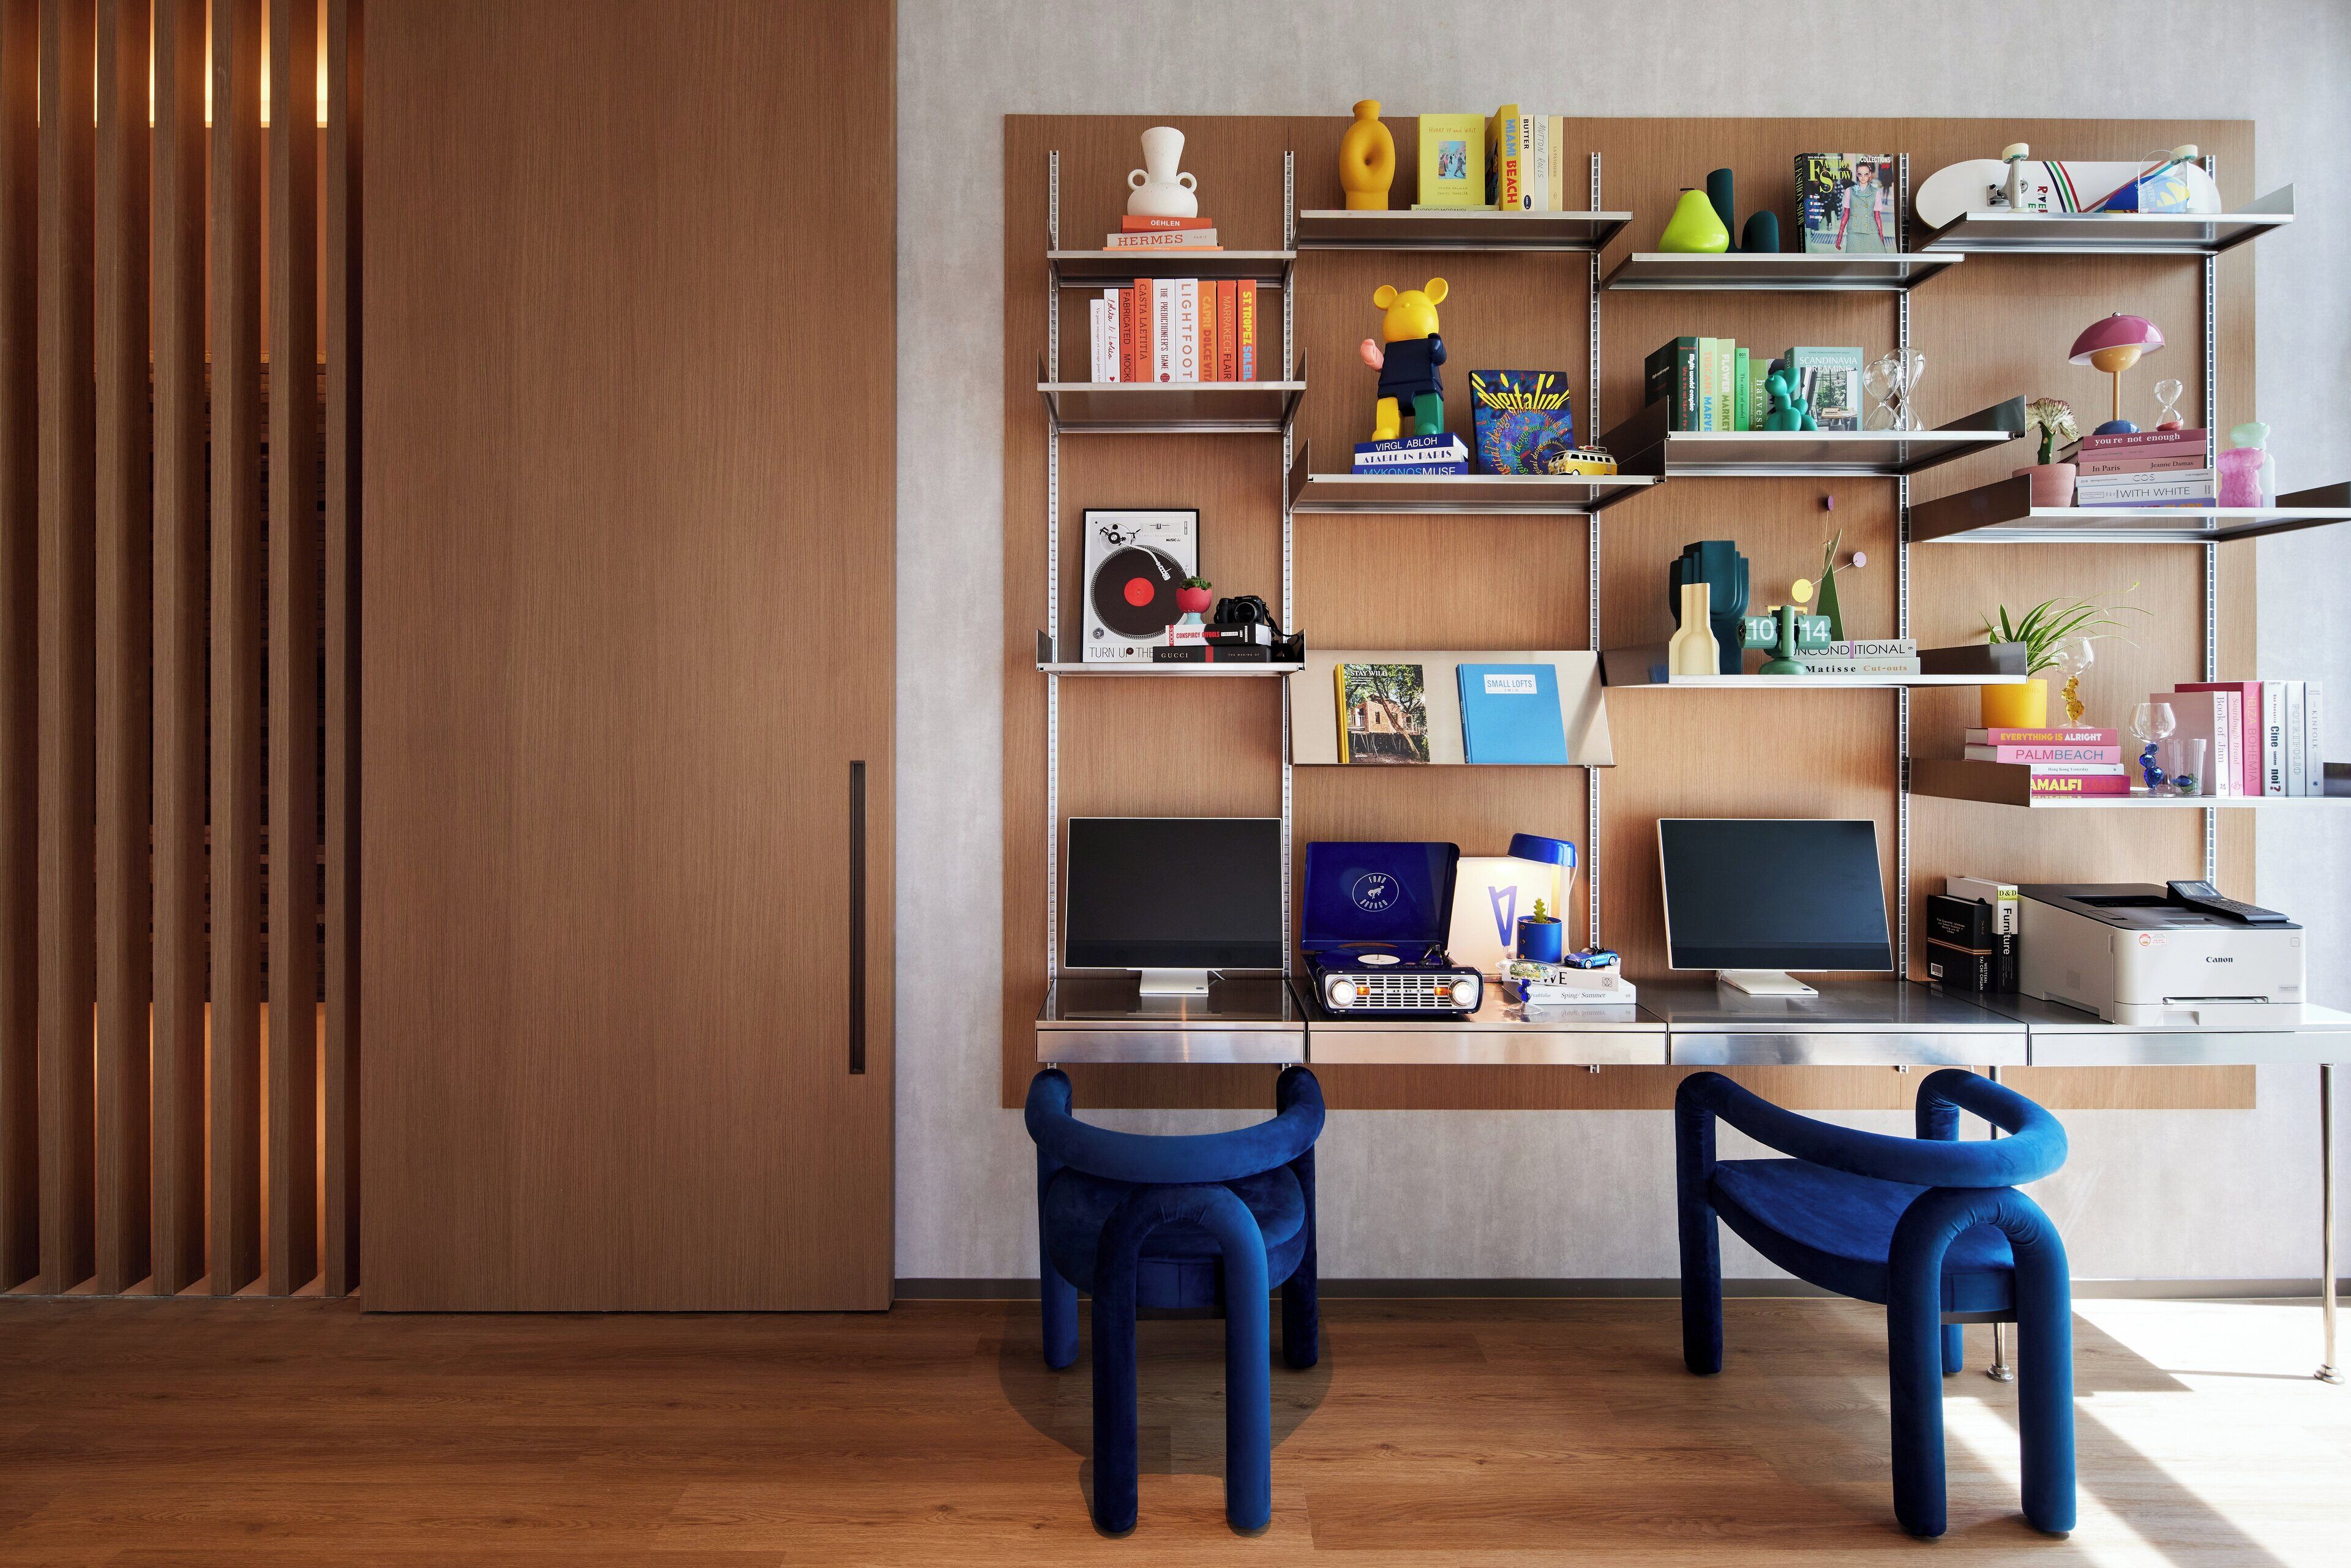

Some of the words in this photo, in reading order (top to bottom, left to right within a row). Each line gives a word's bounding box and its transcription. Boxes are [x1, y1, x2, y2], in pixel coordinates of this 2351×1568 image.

[1505, 118, 1517, 157] MIAMI
[1506, 160, 1517, 203] BEACH
[1243, 291, 1252, 304] ST.
[1202, 296, 1212, 328] CAPRI
[1182, 283, 1192, 378] LIGHTFOOT
[1243, 307, 1252, 345] TROPEZ
[1203, 329, 1212, 361] DOLCE
[1203, 362, 1212, 382] VITA
[1243, 345, 1253, 381] SOLEIL
[1704, 351, 1712, 394] TUSCANY
[1756, 380, 1765, 429] harvest
[1376, 441, 1403, 451] VIRGL
[1406, 437, 1438, 448] ABLOH
[1419, 450, 1452, 460] PARIS
[2120, 489, 2150, 498] WITH
[2153, 487, 2190, 496] WHITE
[1749, 619, 1775, 640] 10
[1801, 621, 1828, 642] 14
[1089, 647, 1114, 658] TURN
[1119, 647, 1134, 658] UP
[1137, 647, 1153, 658] THE
[2216, 697, 2225, 721] Book
[2248, 696, 2257, 725] IBIZA
[2218, 727, 2225, 738] of
[2271, 726, 2280, 748] Cine
[2248, 729, 2257, 782] BOHEMIA
[2031, 779, 2082, 791] AMALFI
[1360, 899, 1388, 909] BRONCO
[2003, 908, 2012, 955] Furniture
